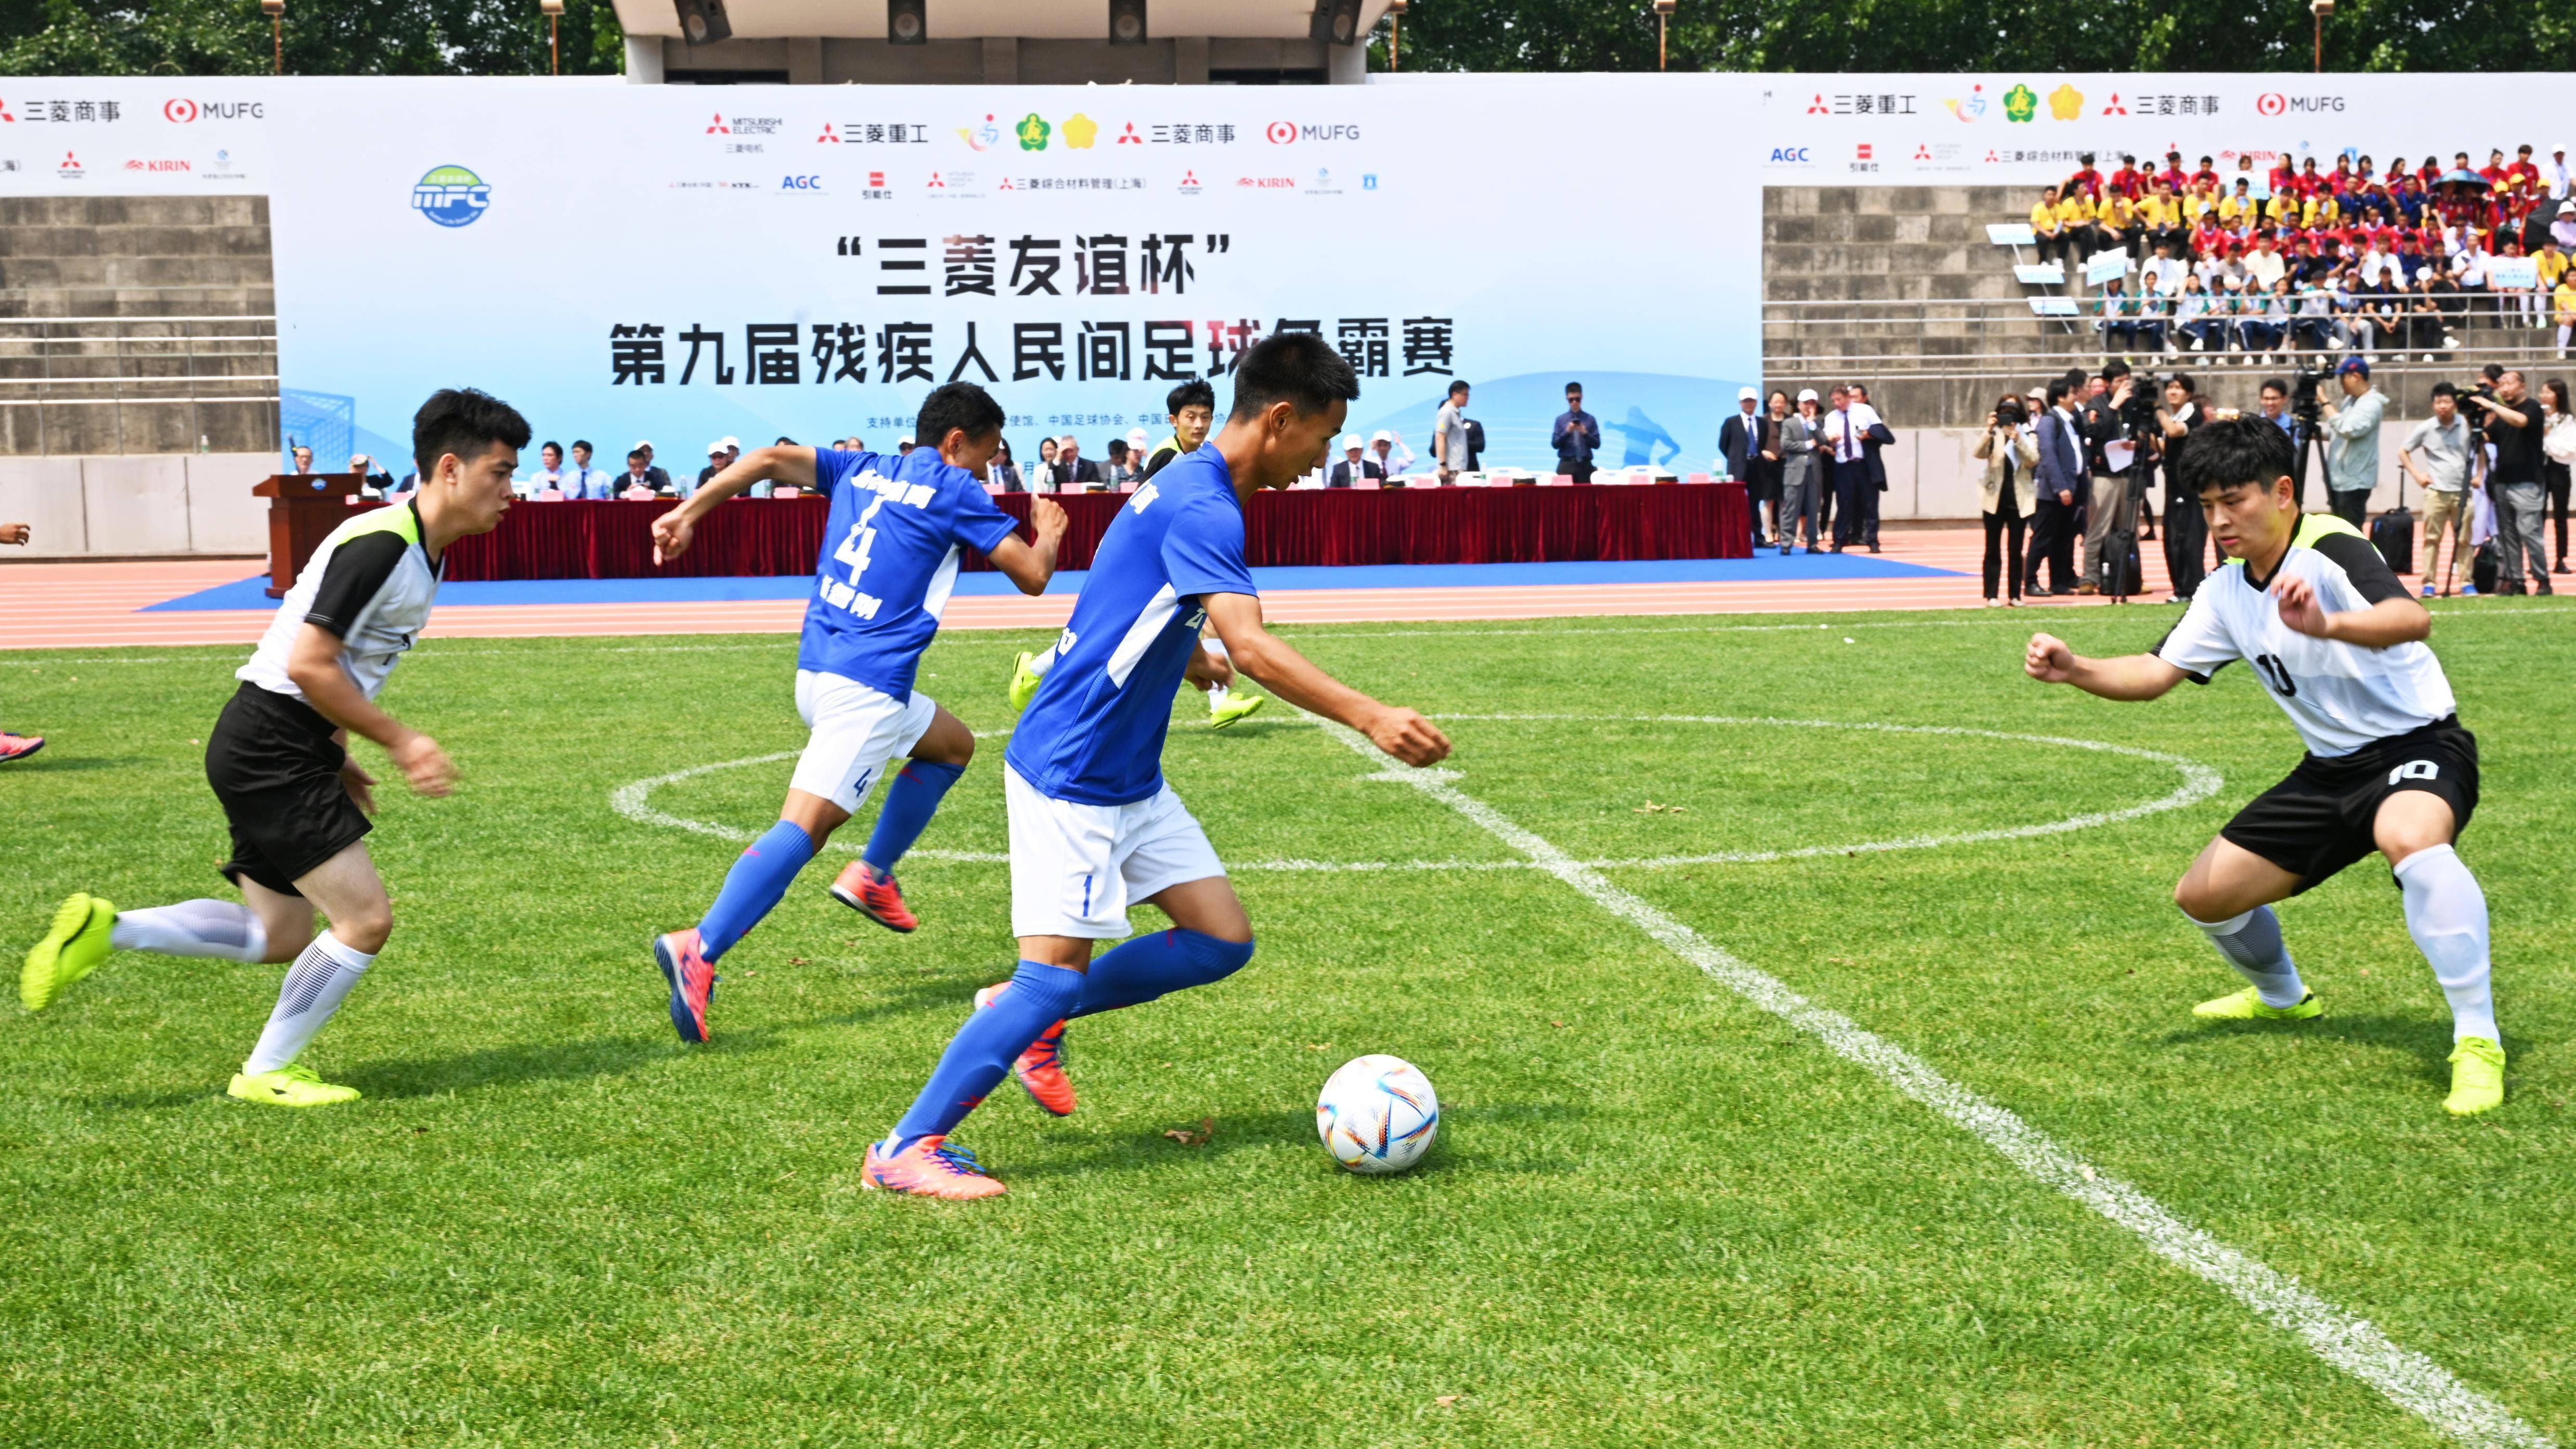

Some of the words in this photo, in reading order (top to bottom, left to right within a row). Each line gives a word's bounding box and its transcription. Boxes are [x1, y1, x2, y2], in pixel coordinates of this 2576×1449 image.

[24, 100, 121, 123] 三菱商事
[203, 102, 264, 119] MUFG
[1834, 95, 1917, 114] 三菱重工
[2136, 95, 2219, 115] 三菱商事
[2290, 97, 2345, 112] MUFG
[733, 126, 776, 135] ELECTRIC
[844, 124, 928, 143] 三菱重工
[1151, 124, 1236, 144] 三菱商事
[1302, 125, 1360, 140] MUFG
[1770, 148, 1809, 162] AGC
[148, 160, 190, 172] KIRIN
[782, 175, 821, 189] AGC
[1258, 177, 1295, 188] KIRIN
[837, 233, 1229, 297] “三菱友谊杯”
[2389, 760, 2439, 785] 10
[853, 768, 872, 797] 4
[1082, 875, 1093, 917] 1
